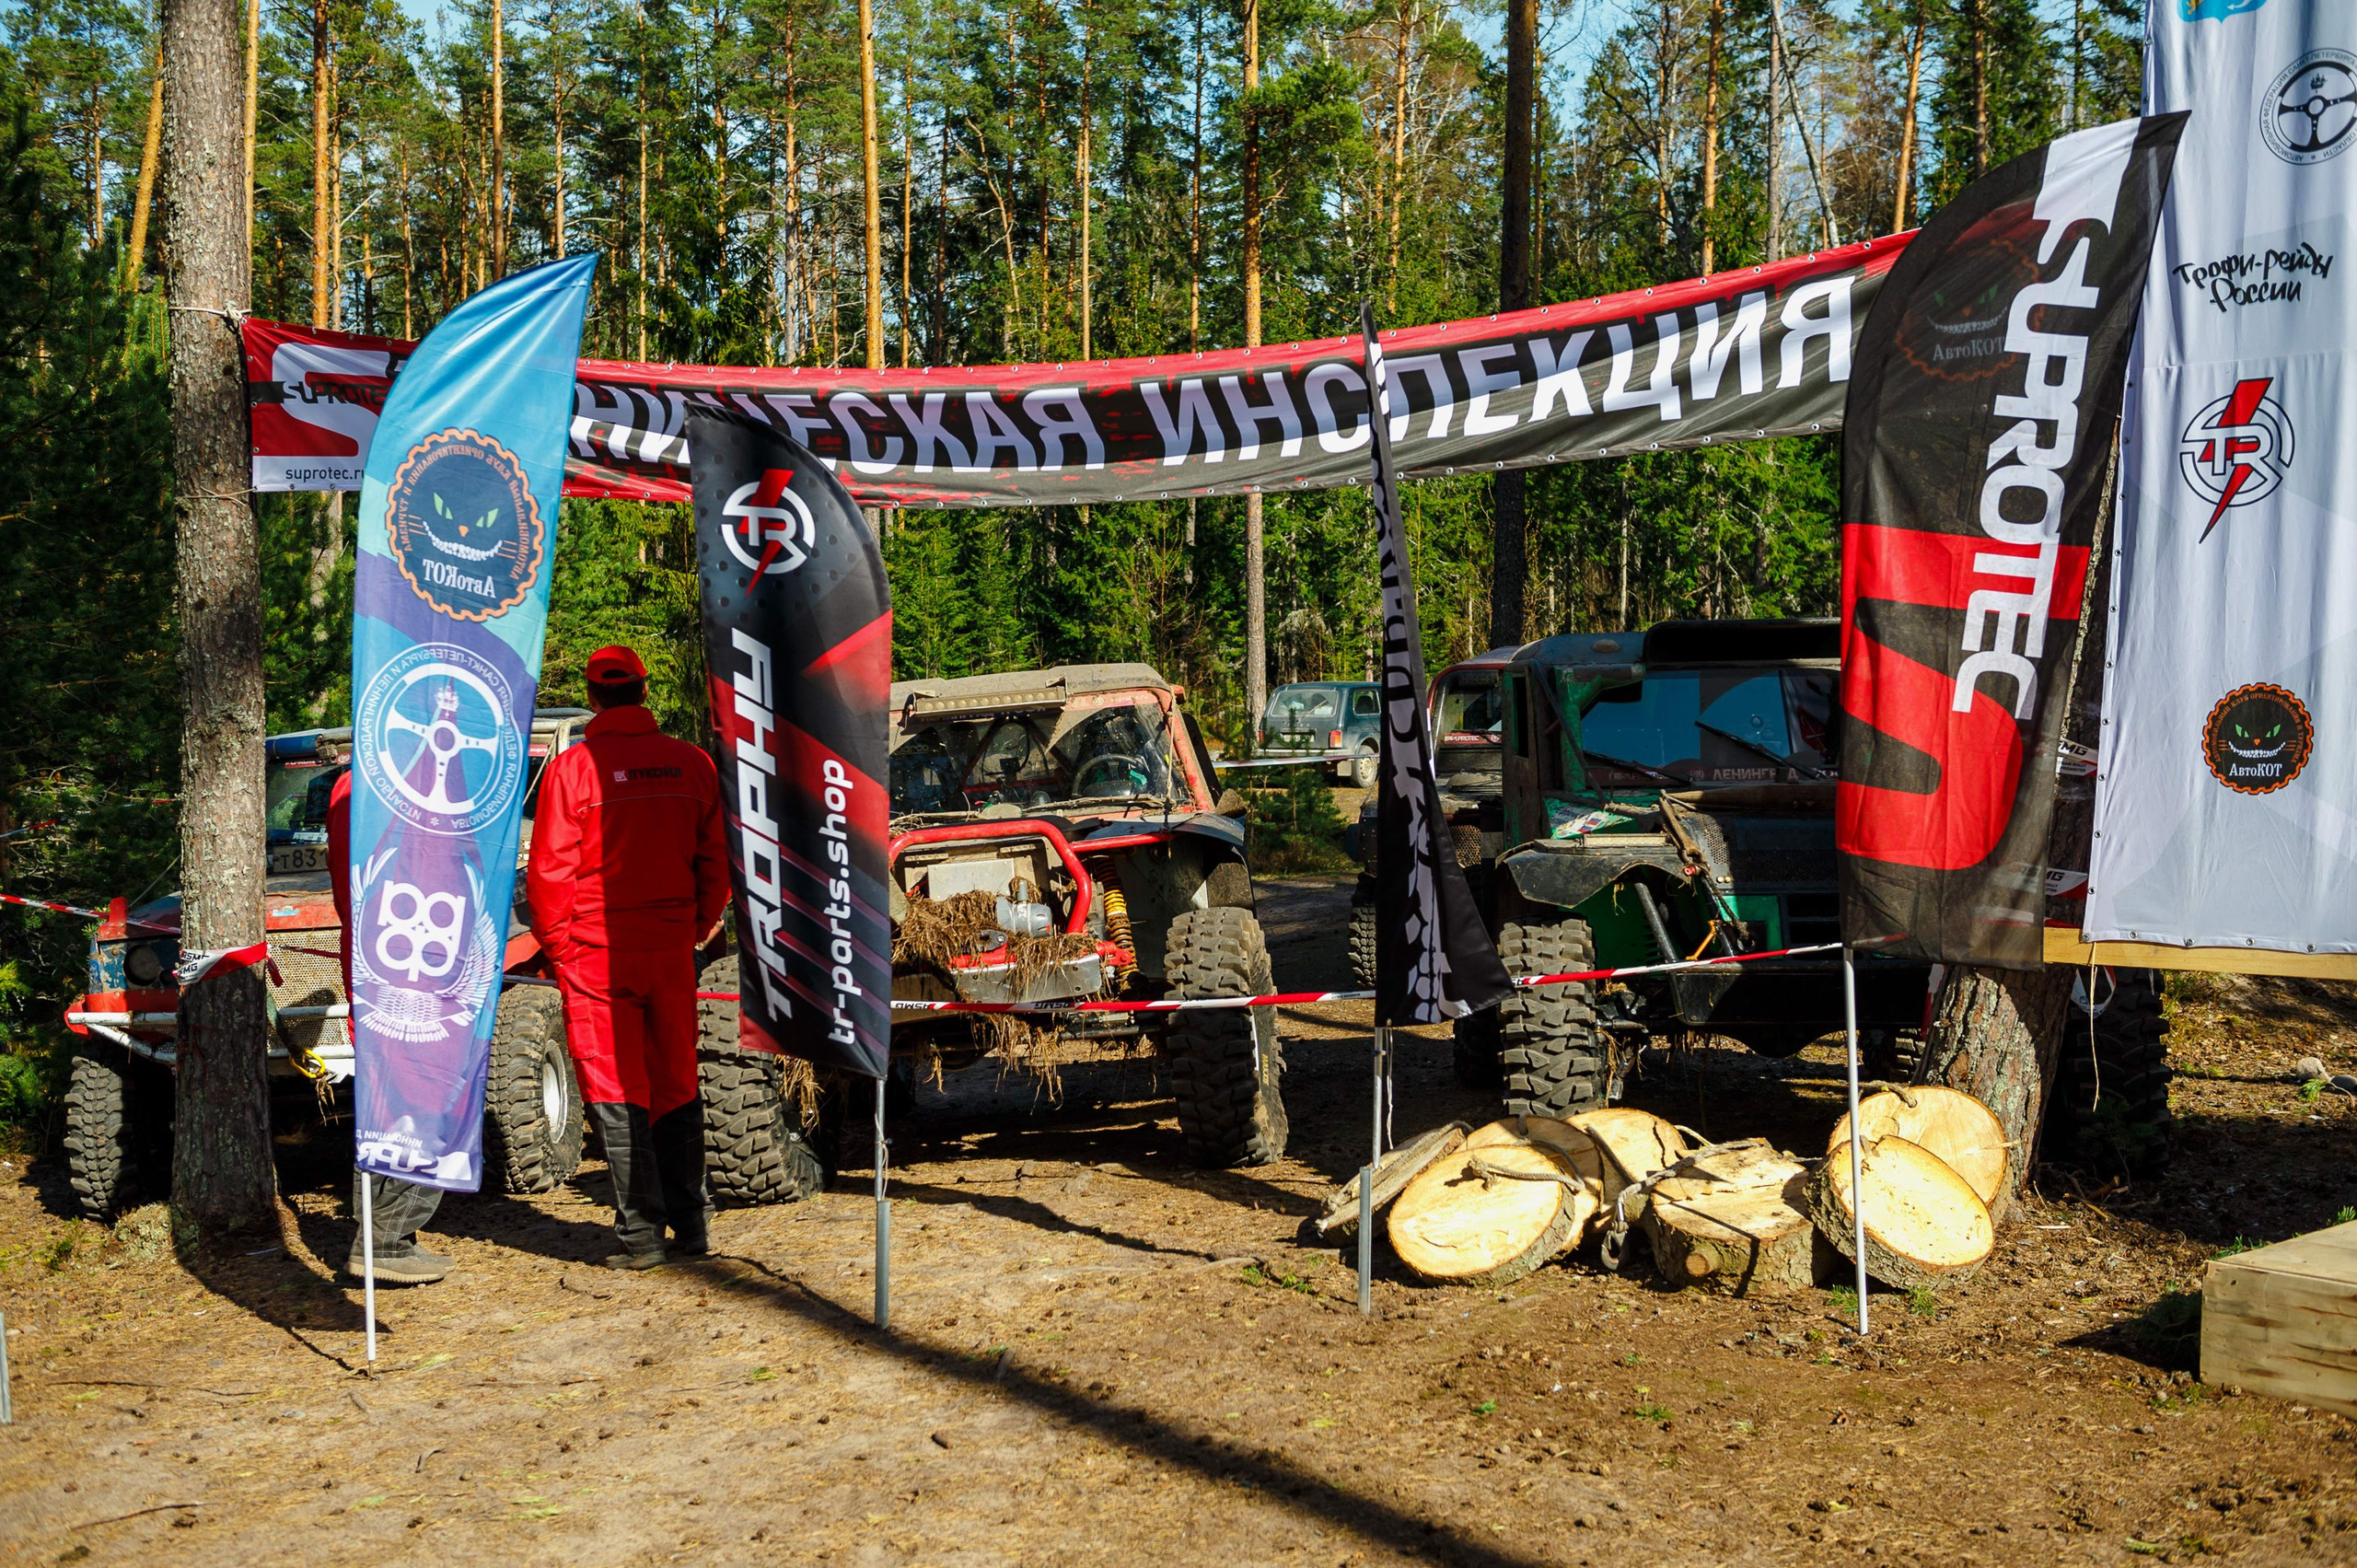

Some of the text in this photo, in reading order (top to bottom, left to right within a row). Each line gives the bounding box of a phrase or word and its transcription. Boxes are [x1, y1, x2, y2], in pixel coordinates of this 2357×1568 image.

[2263, 73, 2290, 117] ФЕДЕРАЦИЯ
[2287, 51, 2356, 75] САНКТ-ПЕТЕРБУРГА
[2173, 241, 2334, 289] Трофи-рейды
[2209, 277, 2302, 312] России
[282, 380, 389, 405] SUPROTE
[1140, 274, 1856, 468] ИНСПЕКЦИЯ
[1951, 175, 2120, 721] SUPROTEC
[1713, 767, 1799, 782] ЛЕНИНГРД
[2228, 762, 2282, 777] АвтоКОТ
[731, 627, 795, 1024] TROPHY
[826, 758, 863, 1046] tr-parts.shop
